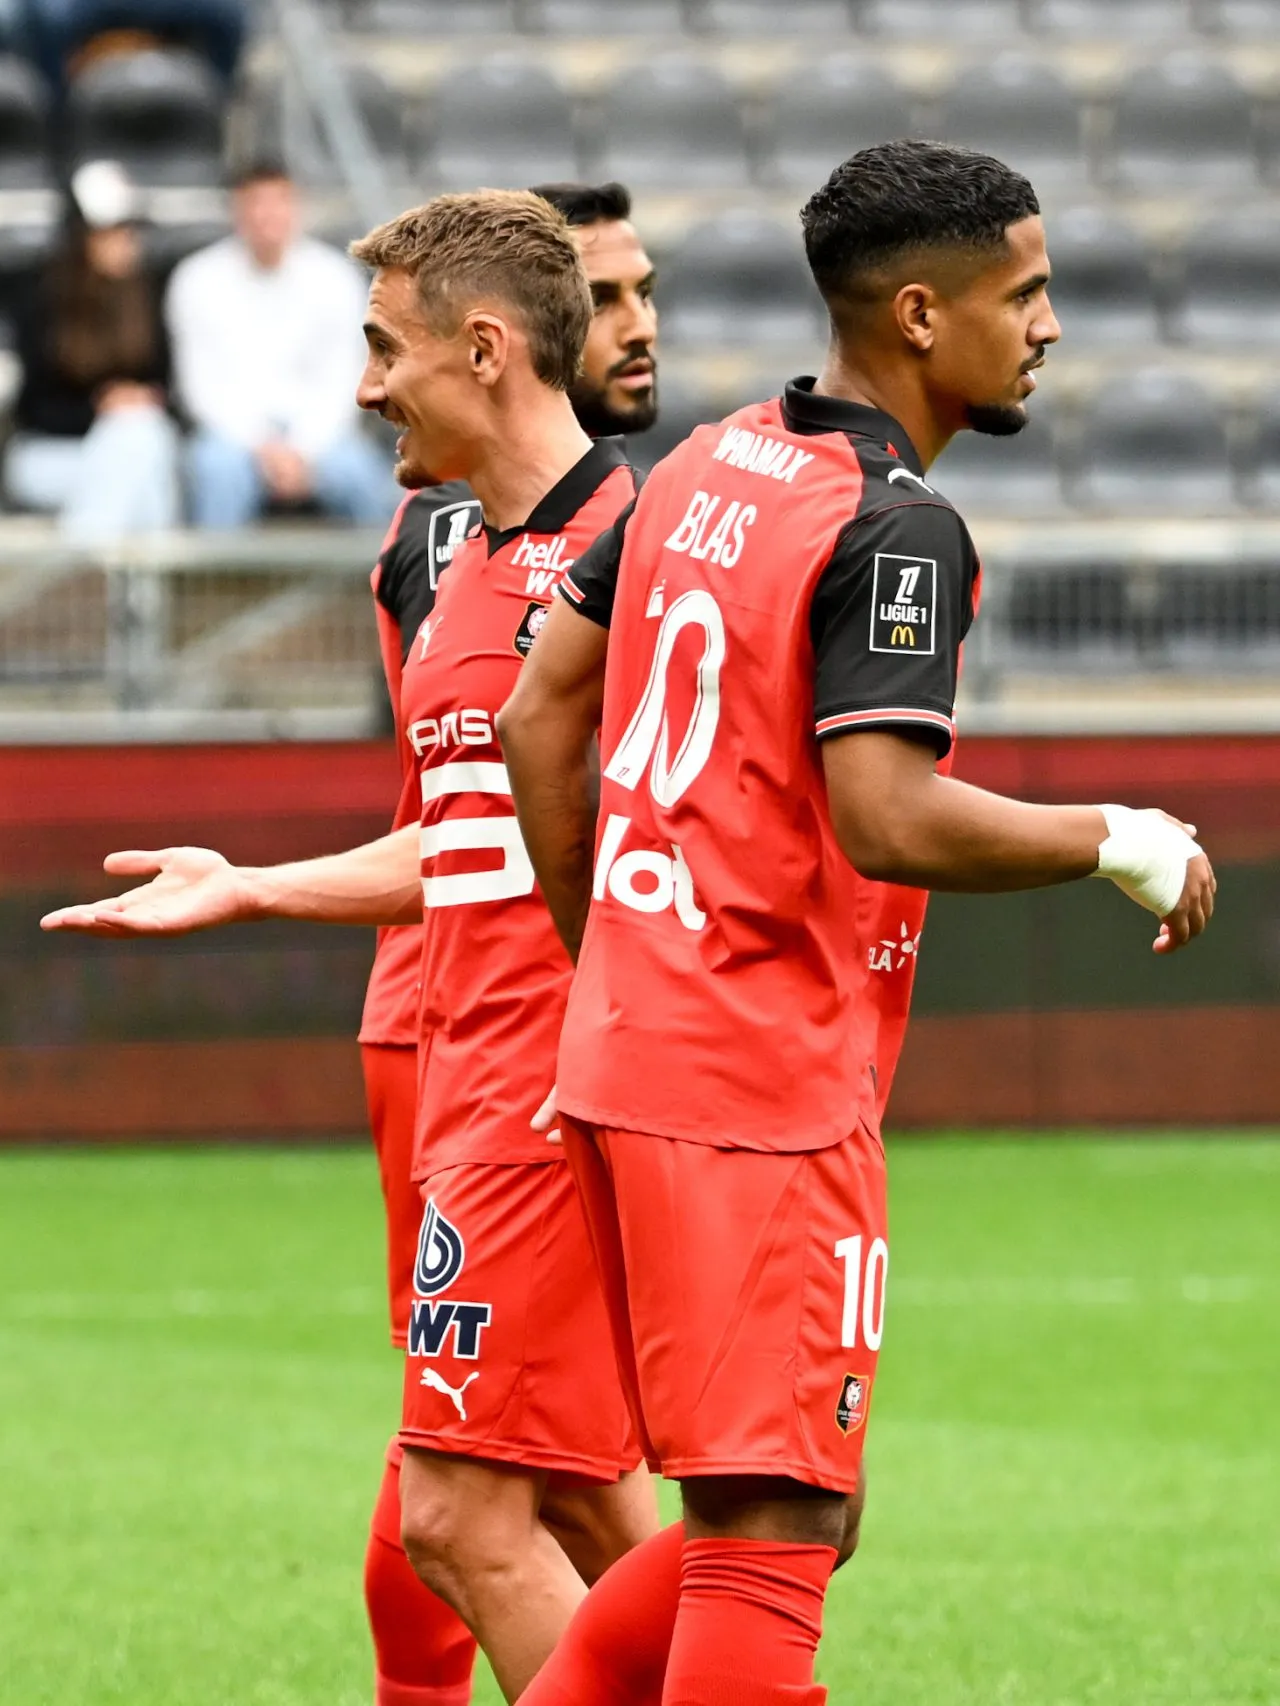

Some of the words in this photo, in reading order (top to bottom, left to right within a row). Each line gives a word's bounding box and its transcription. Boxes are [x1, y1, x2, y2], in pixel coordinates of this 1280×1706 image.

[664, 490, 757, 569] BLAS
[880, 603, 919, 624] LIGUE
[920, 607, 927, 624] 1
[868, 947, 892, 972] LA
[834, 1234, 888, 1351] 10
